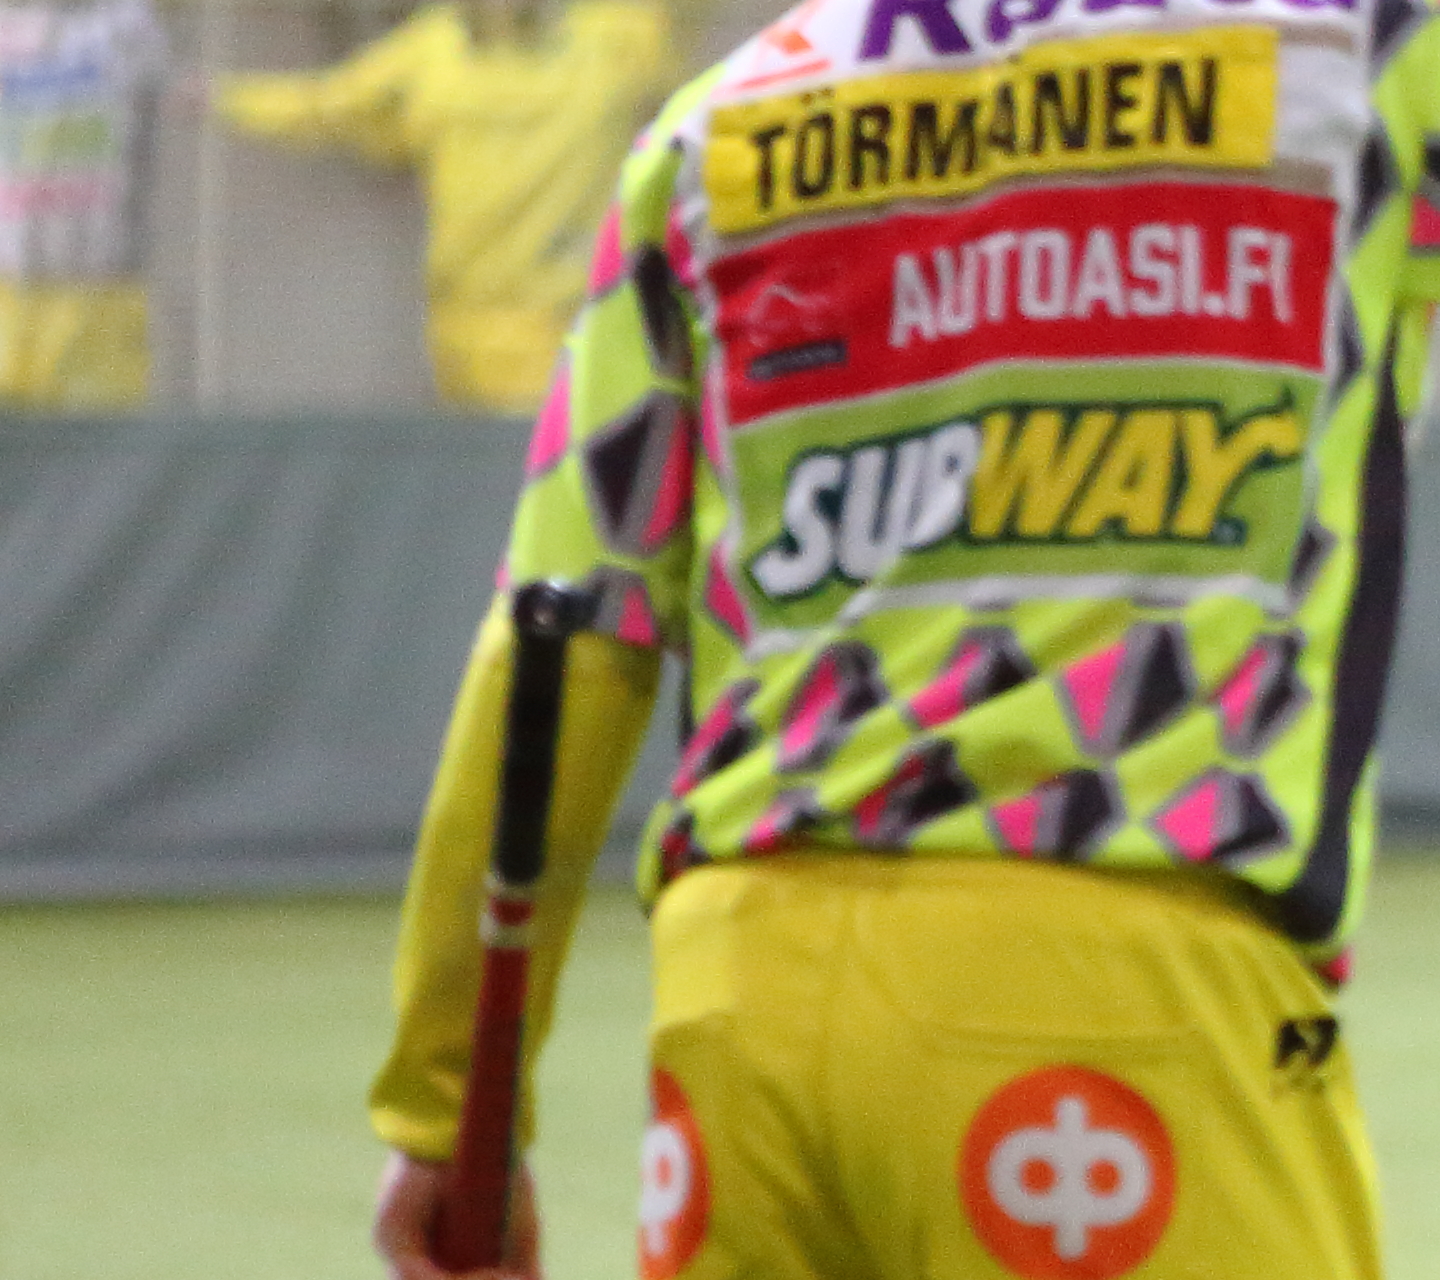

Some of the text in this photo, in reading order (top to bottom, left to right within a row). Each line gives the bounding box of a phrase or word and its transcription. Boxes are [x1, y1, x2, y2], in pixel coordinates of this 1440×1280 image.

[749, 55, 1220, 211] TÖRMÄNEN
[888, 222, 1294, 348] AUTOASI.FI
[747, 390, 1302, 601] SUBWAY
